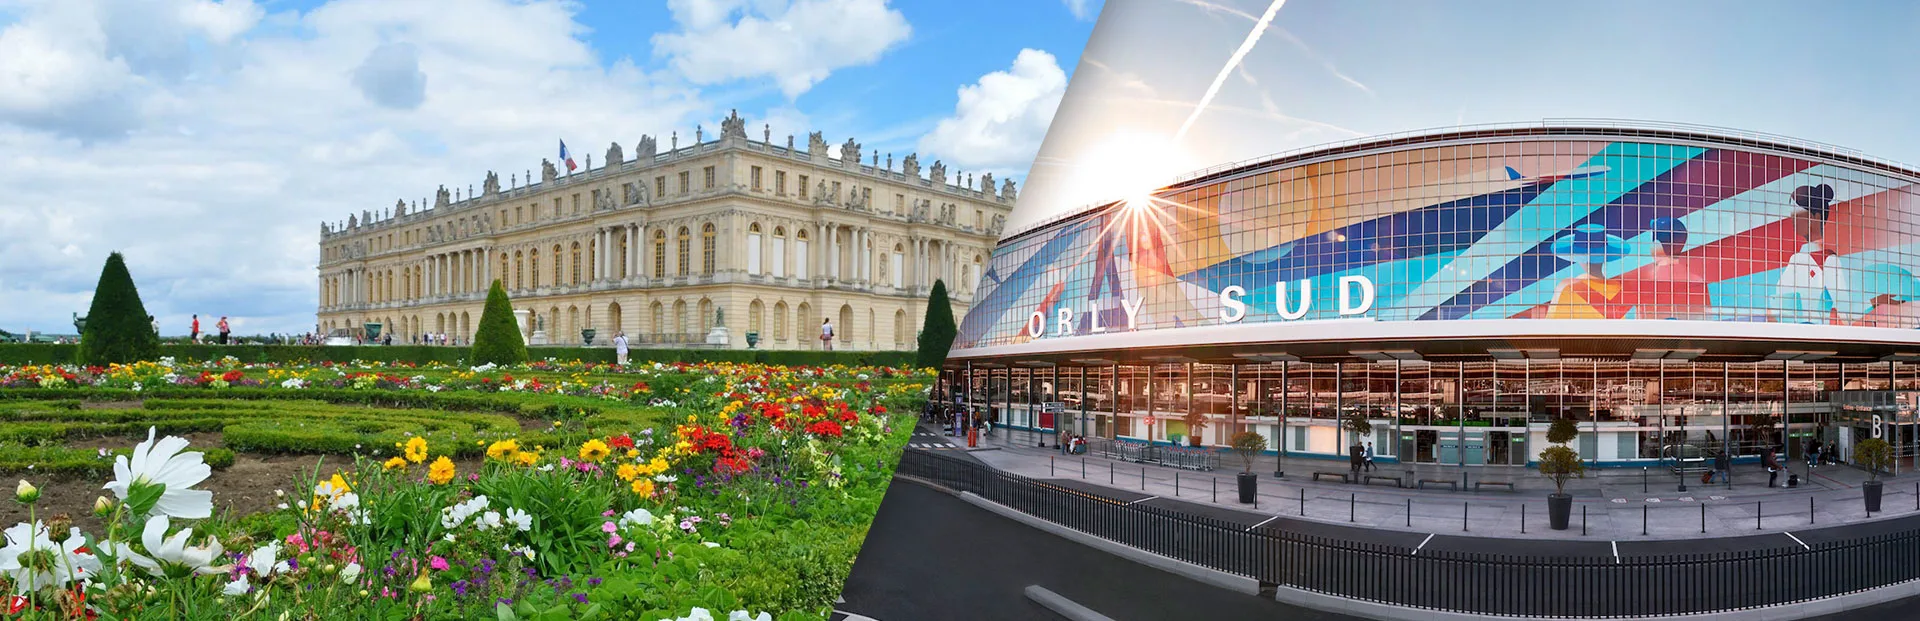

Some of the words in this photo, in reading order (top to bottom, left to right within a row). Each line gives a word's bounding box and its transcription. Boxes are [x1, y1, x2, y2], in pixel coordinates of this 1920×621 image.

[1028, 297, 1145, 338] ORLY
[1219, 275, 1375, 323] SUD
[1872, 414, 1882, 439] B
